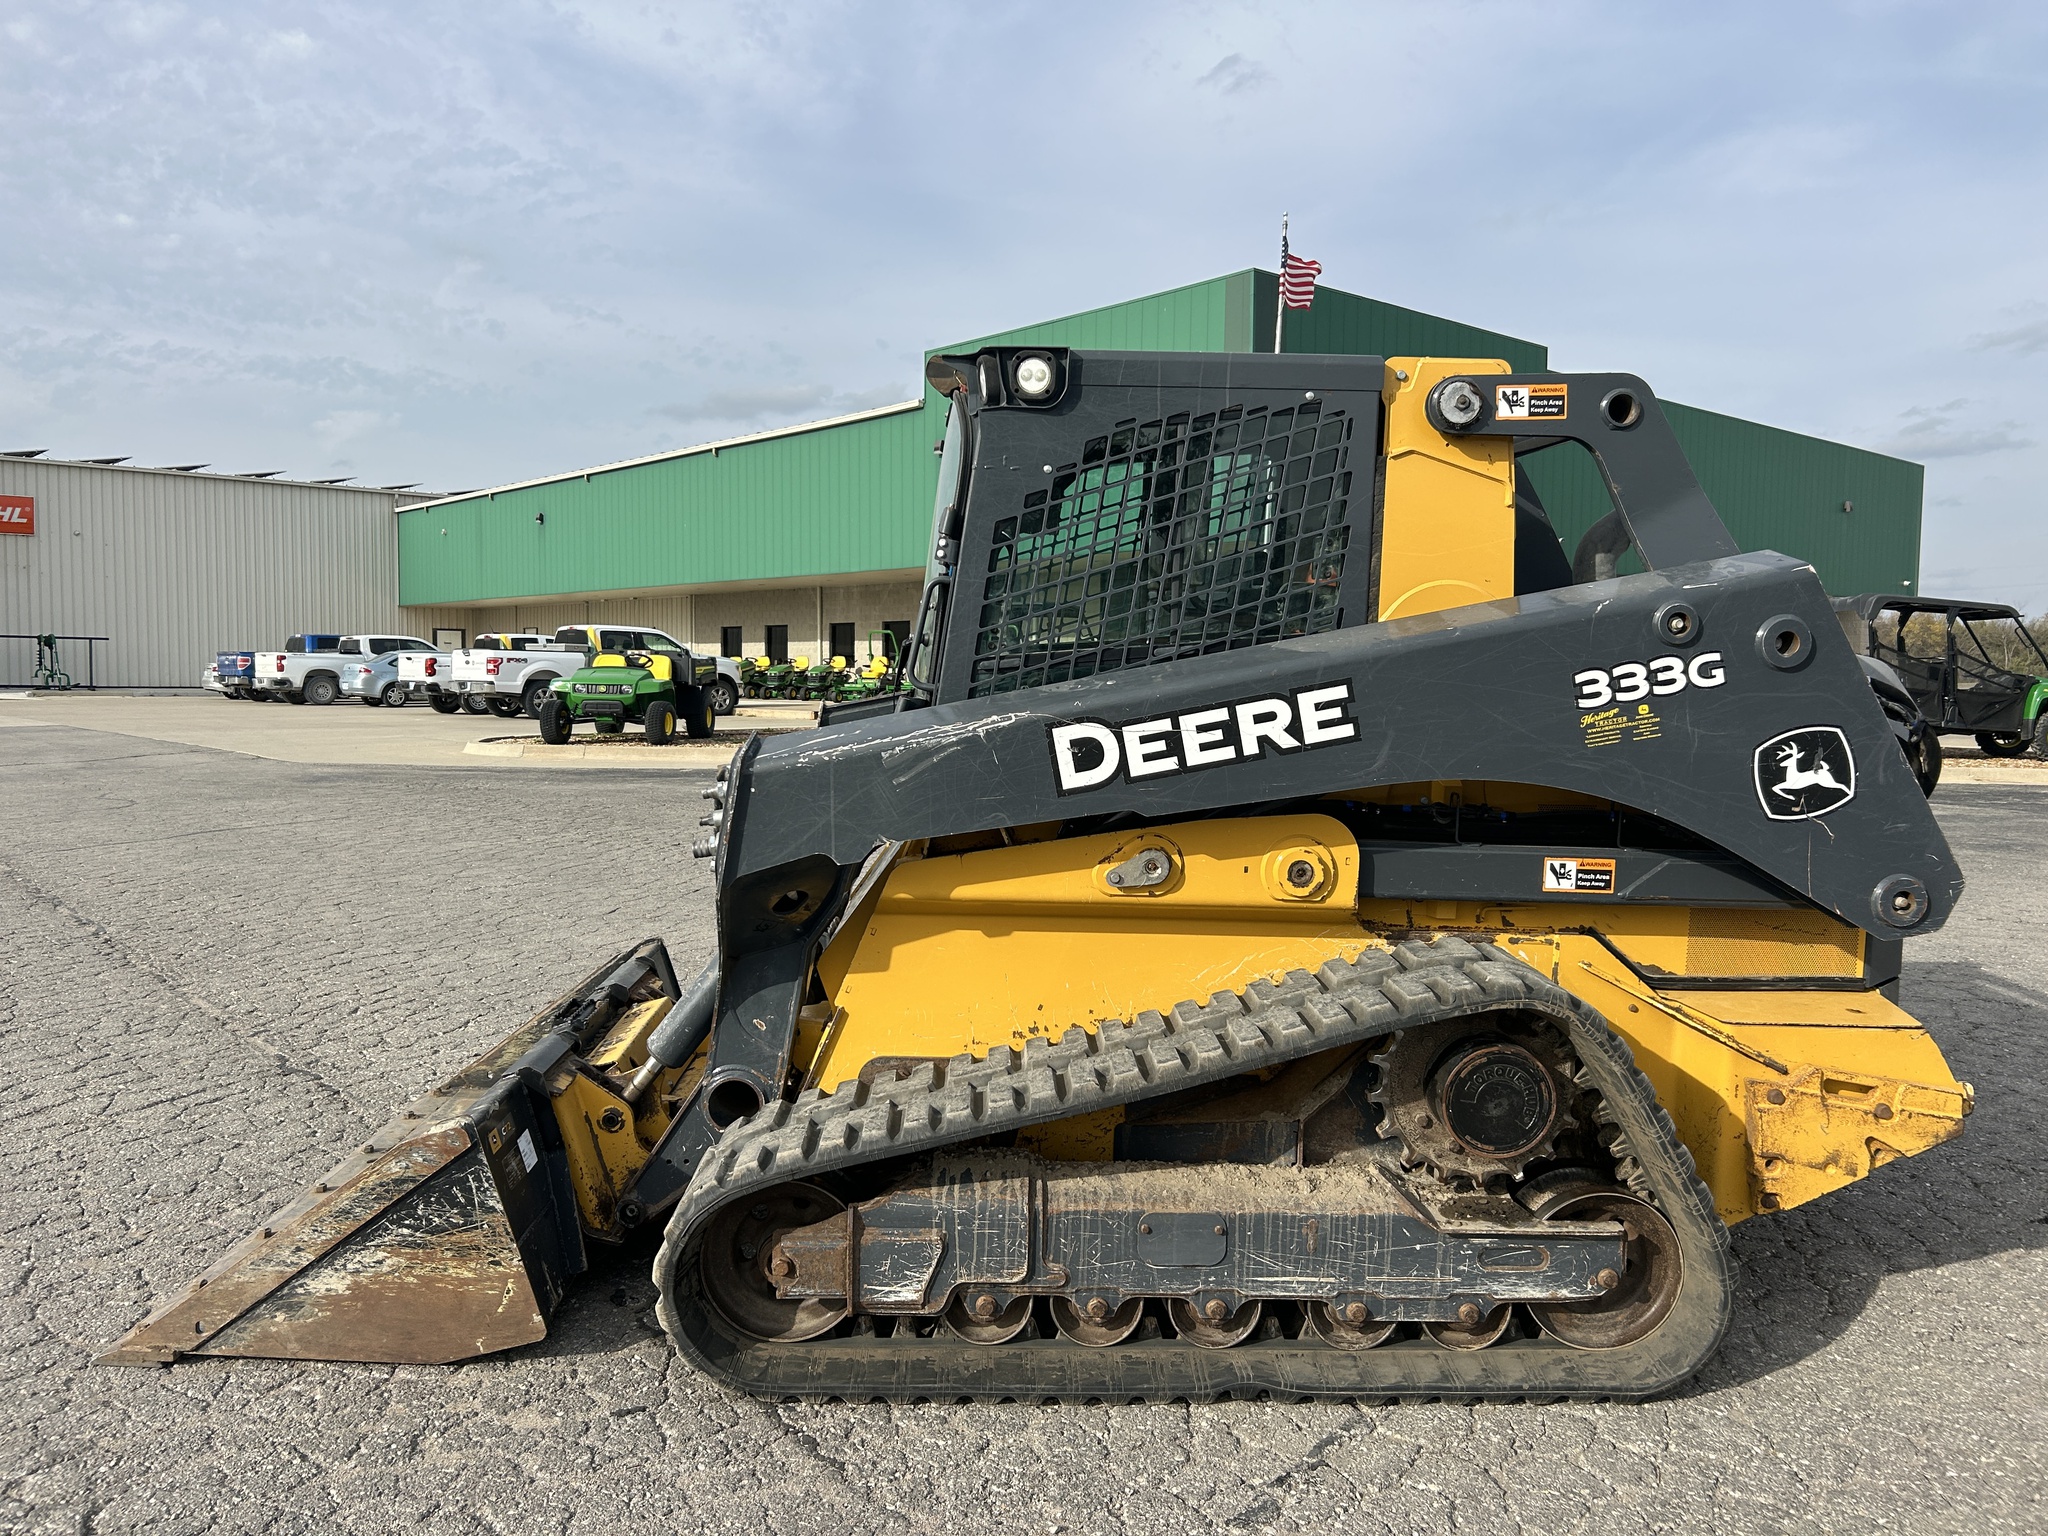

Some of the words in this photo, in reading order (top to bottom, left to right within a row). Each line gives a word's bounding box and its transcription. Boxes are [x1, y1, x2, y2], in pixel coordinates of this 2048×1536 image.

[1574, 651, 1726, 709] 333G
[1580, 707, 1620, 728] Heritage
[1594, 716, 1628, 728] TRACTOR
[1052, 685, 1355, 790] DEERE
